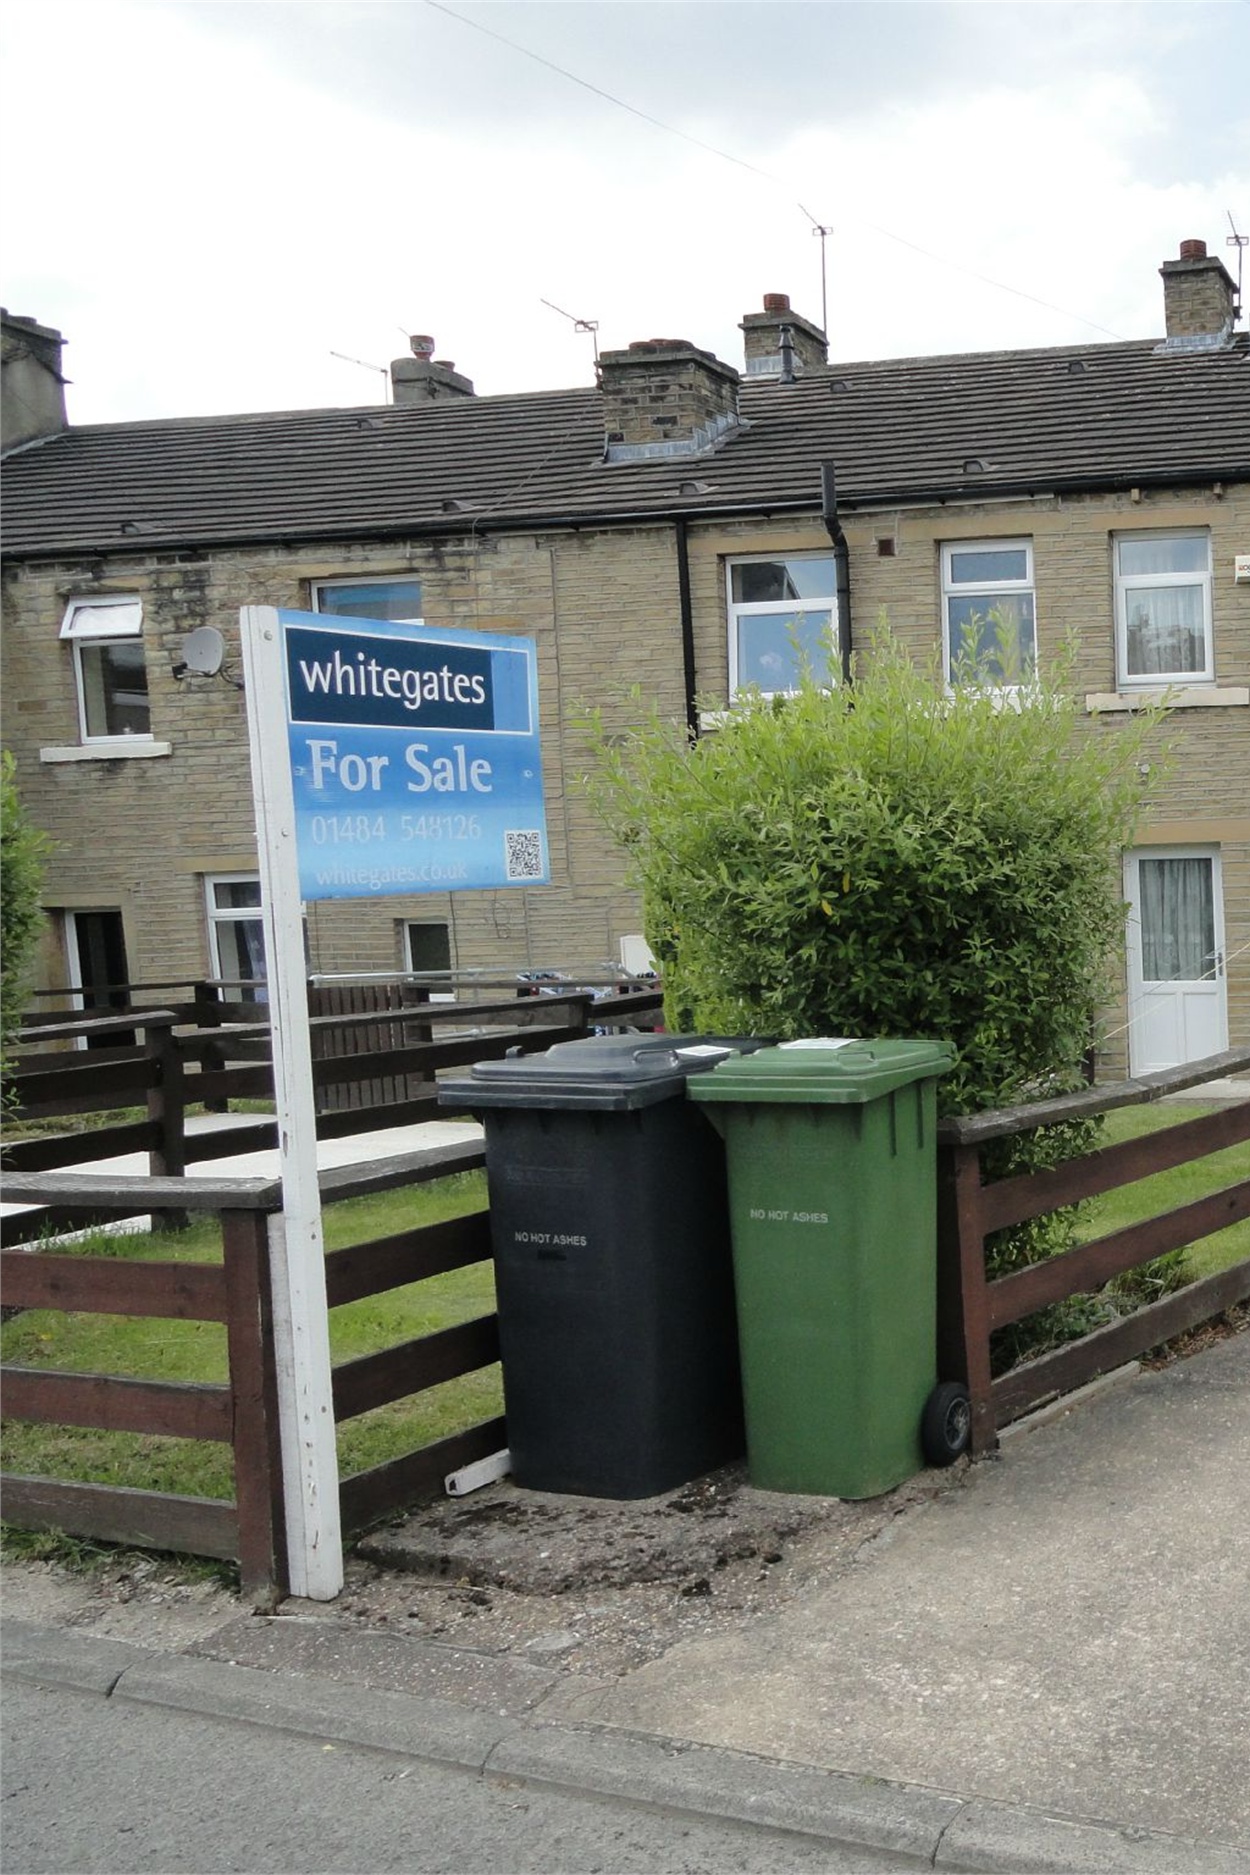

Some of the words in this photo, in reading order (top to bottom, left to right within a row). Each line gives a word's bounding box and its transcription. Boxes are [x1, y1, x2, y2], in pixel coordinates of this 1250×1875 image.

[300, 650, 486, 710] whitegates
[305, 739, 389, 791] For
[405, 743, 493, 792] Sale
[312, 815, 387, 845] 01484
[401, 814, 482, 842] 548126
[317, 859, 468, 890] whitegates.co.uk
[750, 1209, 766, 1219] NO
[768, 1210, 789, 1221] HOT
[792, 1212, 829, 1223] ASHES
[514, 1231, 529, 1242] NO
[530, 1233, 551, 1244] HOT
[552, 1234, 587, 1246] ASHES
